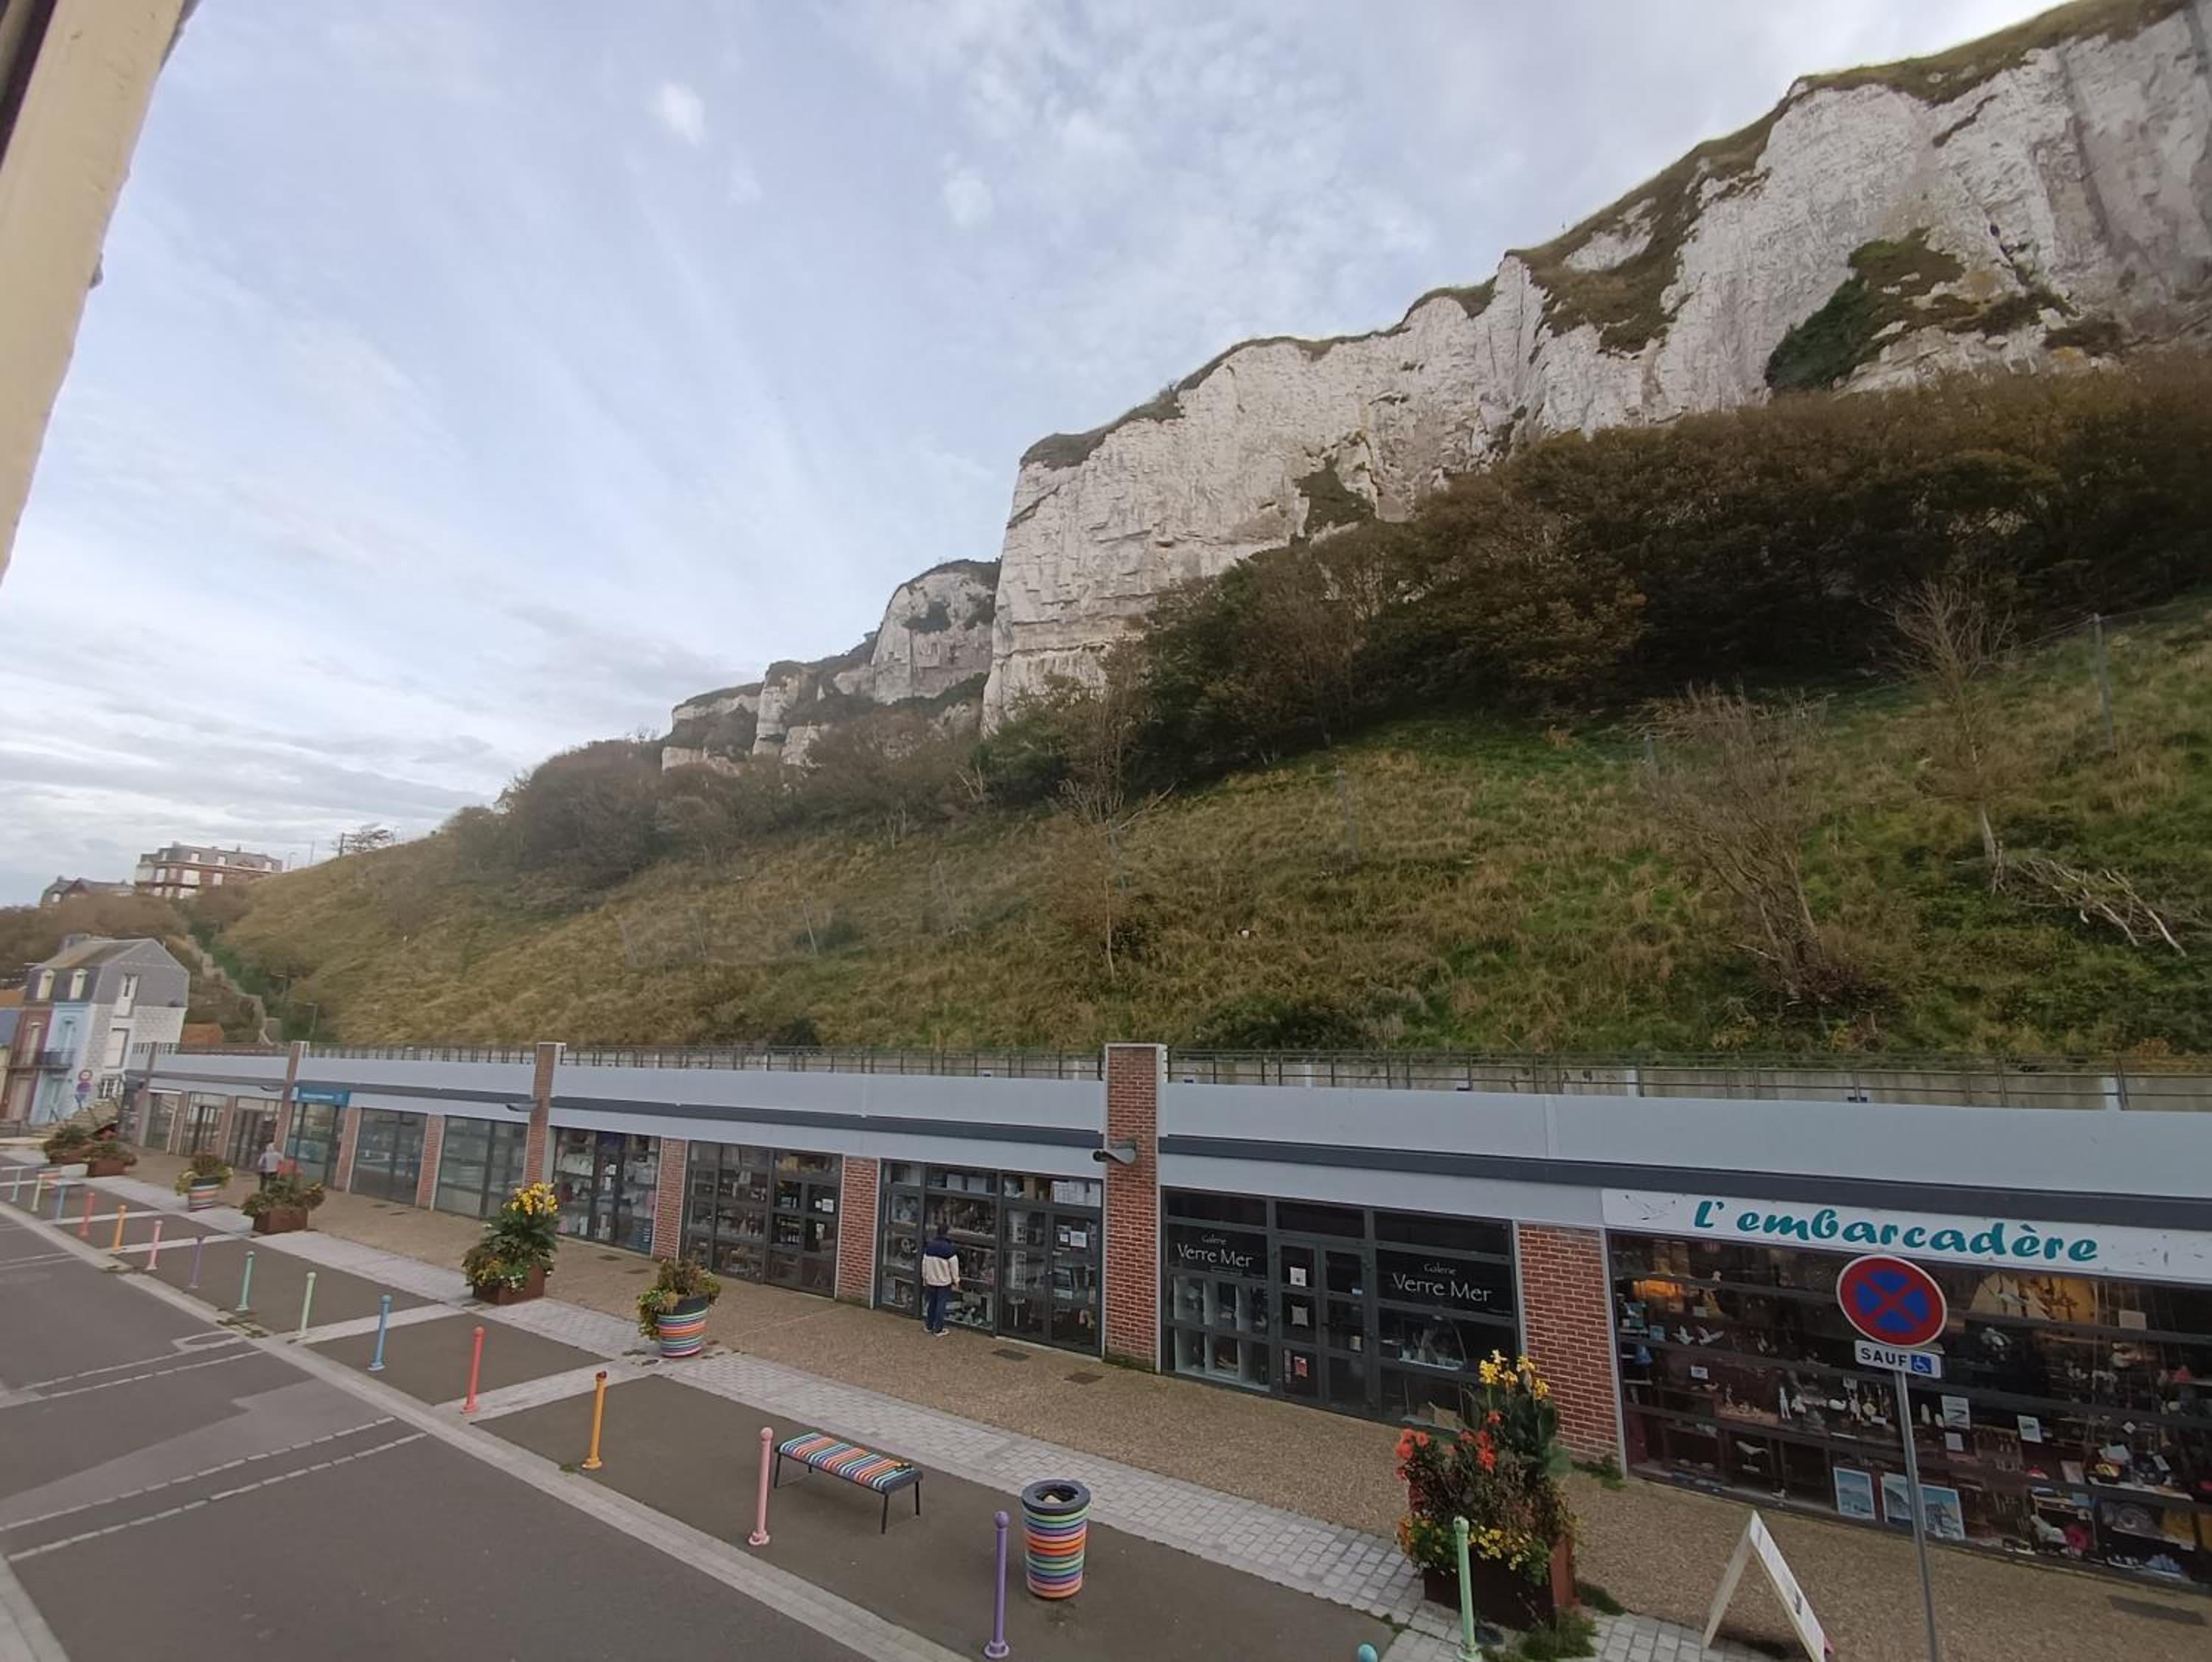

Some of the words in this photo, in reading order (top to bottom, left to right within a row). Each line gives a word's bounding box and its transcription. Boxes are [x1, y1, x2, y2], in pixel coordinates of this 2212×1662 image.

[1177, 1242, 1217, 1263] Verre
[1220, 1248, 1253, 1268] Mer
[1393, 1273, 1445, 1296] Verre
[1450, 1280, 1492, 1302] Mer
[1860, 1347, 1907, 1366] SAUF
